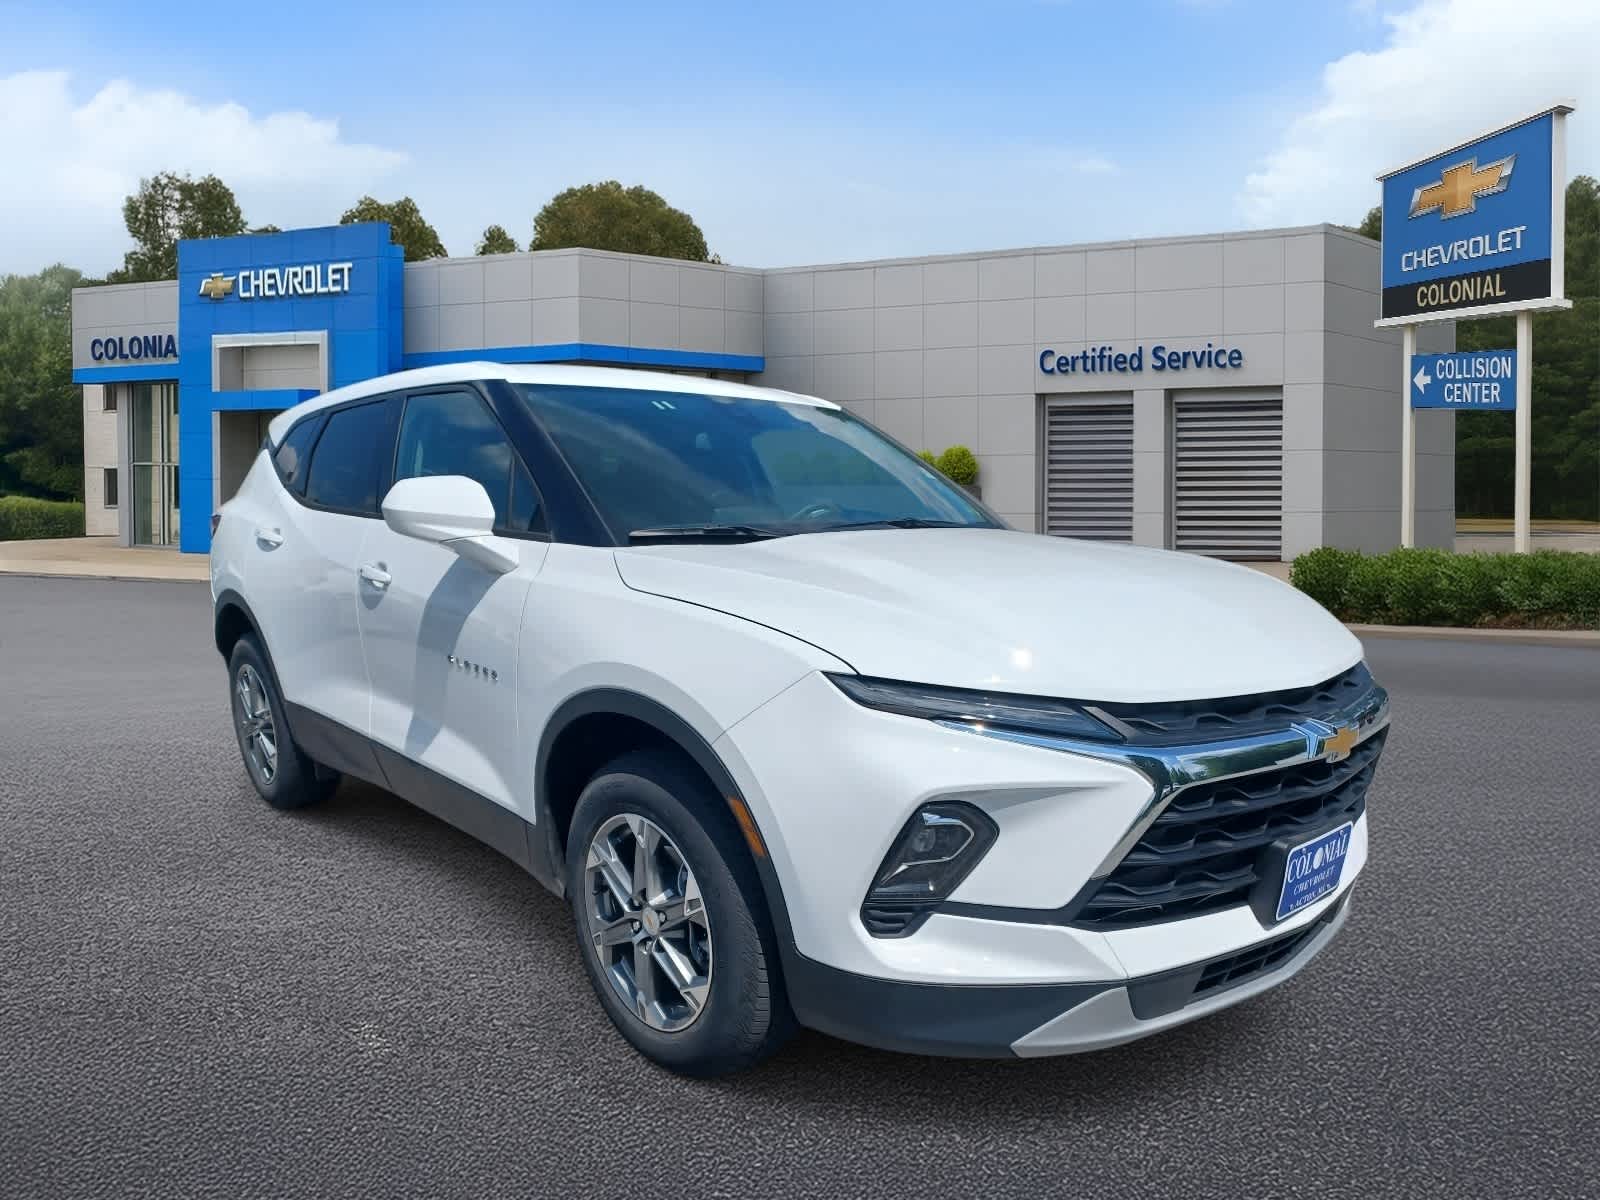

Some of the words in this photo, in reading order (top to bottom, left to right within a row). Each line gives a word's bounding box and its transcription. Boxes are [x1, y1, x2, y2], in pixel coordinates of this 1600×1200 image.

[1401, 225, 1528, 273] CHEVROLET
[238, 262, 353, 299] CHEVROLET
[1416, 274, 1506, 307] COLONIAL
[91, 335, 179, 361] COLONIA
[1039, 346, 1144, 375] Certified
[1151, 343, 1244, 371] Service
[1436, 356, 1512, 379] COLLISION
[1444, 382, 1501, 403] CENTER
[1288, 833, 1348, 883] COLONIAL
